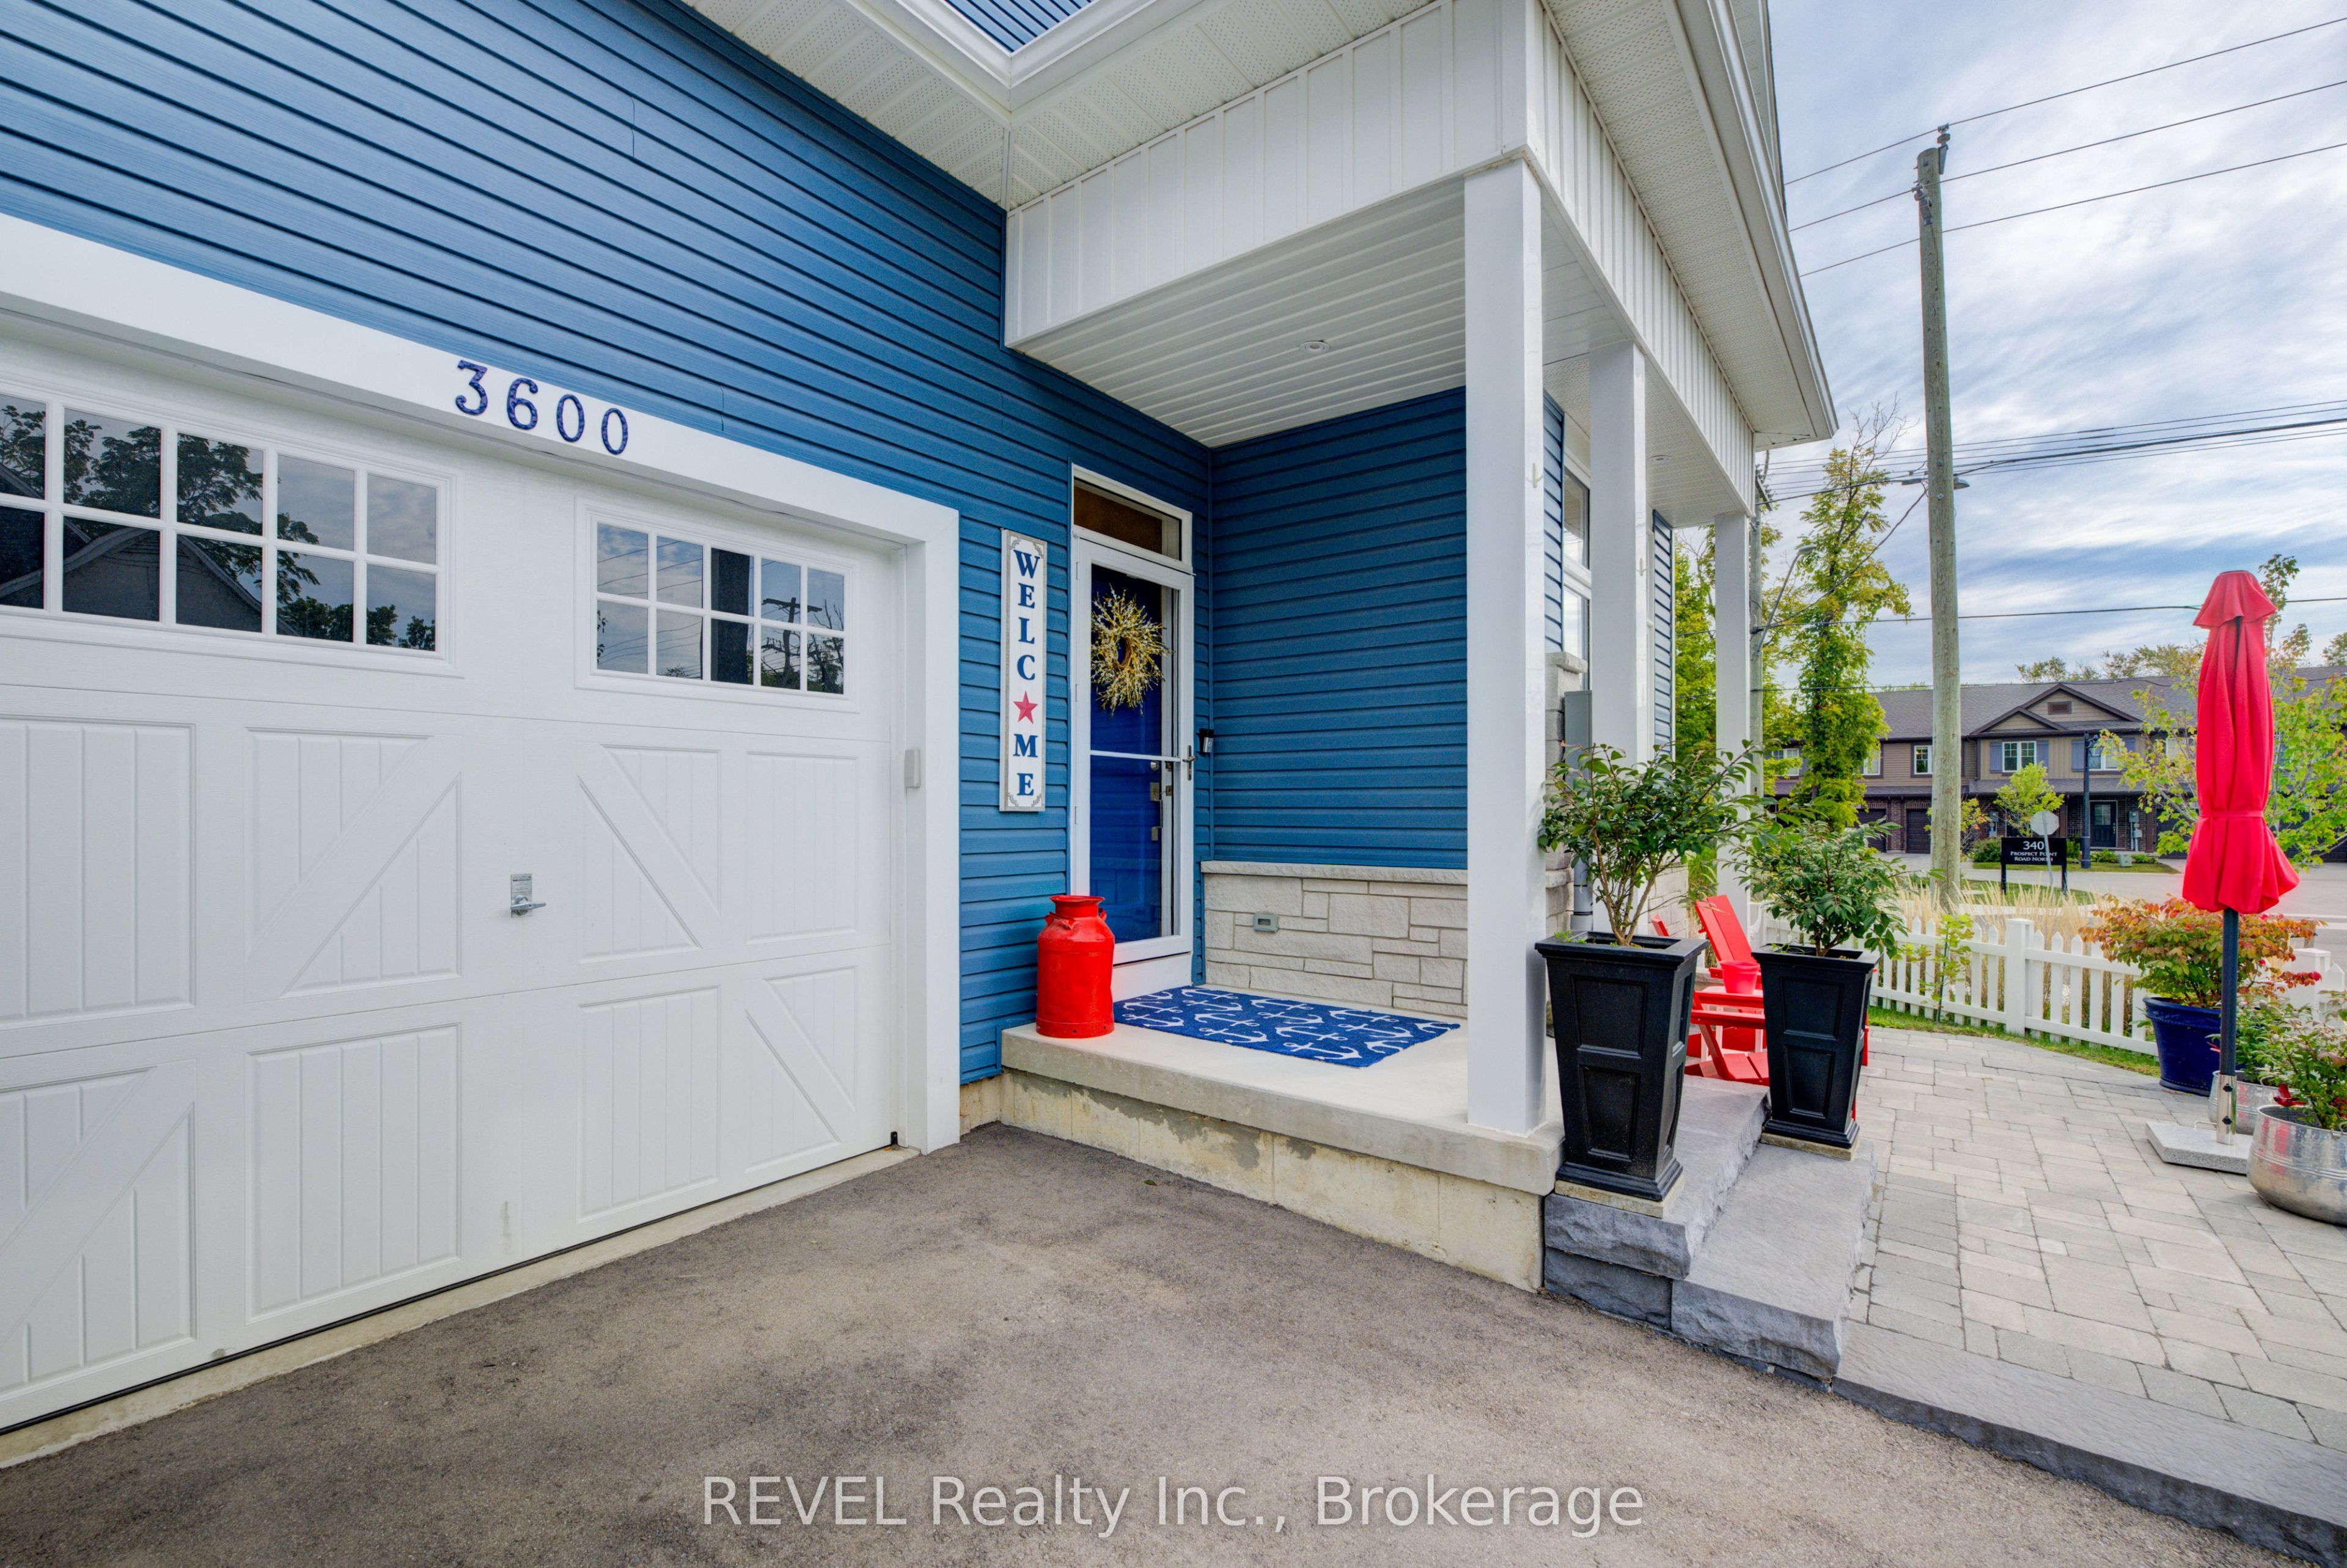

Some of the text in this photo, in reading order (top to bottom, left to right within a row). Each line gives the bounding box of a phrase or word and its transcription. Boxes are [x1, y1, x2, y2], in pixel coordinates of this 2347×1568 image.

[455, 360, 628, 455] 3600
[1013, 549, 1041, 796] WELCME
[2023, 841, 2044, 850] 340
